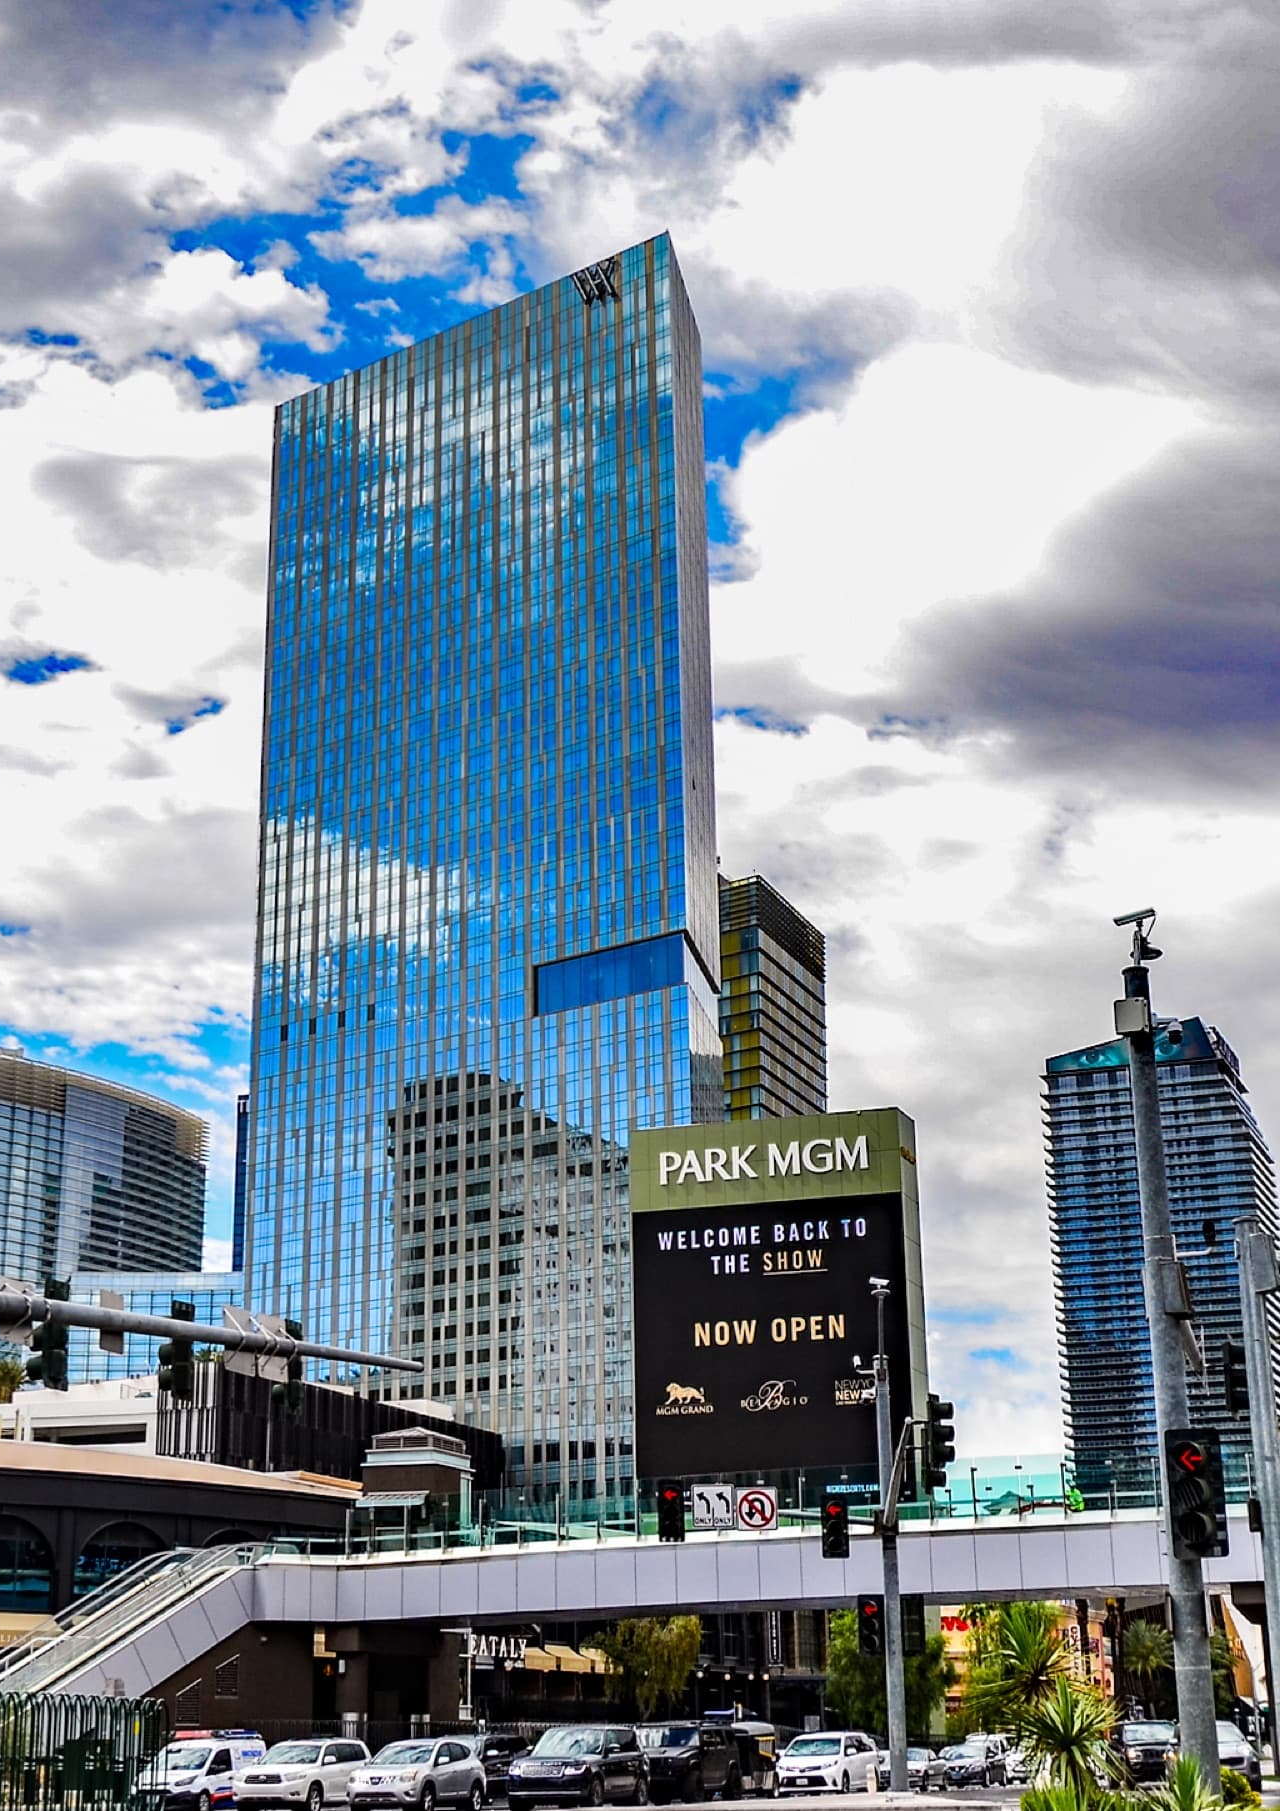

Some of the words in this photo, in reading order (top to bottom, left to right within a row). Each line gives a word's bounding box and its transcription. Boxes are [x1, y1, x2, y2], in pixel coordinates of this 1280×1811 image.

[659, 1144, 758, 1186] PARK
[768, 1135, 869, 1177] MGM
[658, 1226, 761, 1251] WELCOME
[774, 1220, 830, 1243] BACK
[841, 1218, 867, 1238] TO
[711, 1254, 750, 1275] THE
[763, 1249, 823, 1272] SHOW
[694, 1319, 757, 1347] NOW
[771, 1314, 845, 1343] OPEN
[835, 1390, 860, 1401] NEW
[655, 1406, 680, 1416] MGM
[680, 1404, 714, 1415] GRAND
[695, 1517, 711, 1525] ONLY
[715, 1516, 731, 1525] ONLY
[941, 1616, 969, 1631] VS
[470, 1634, 527, 1659] EATALY
